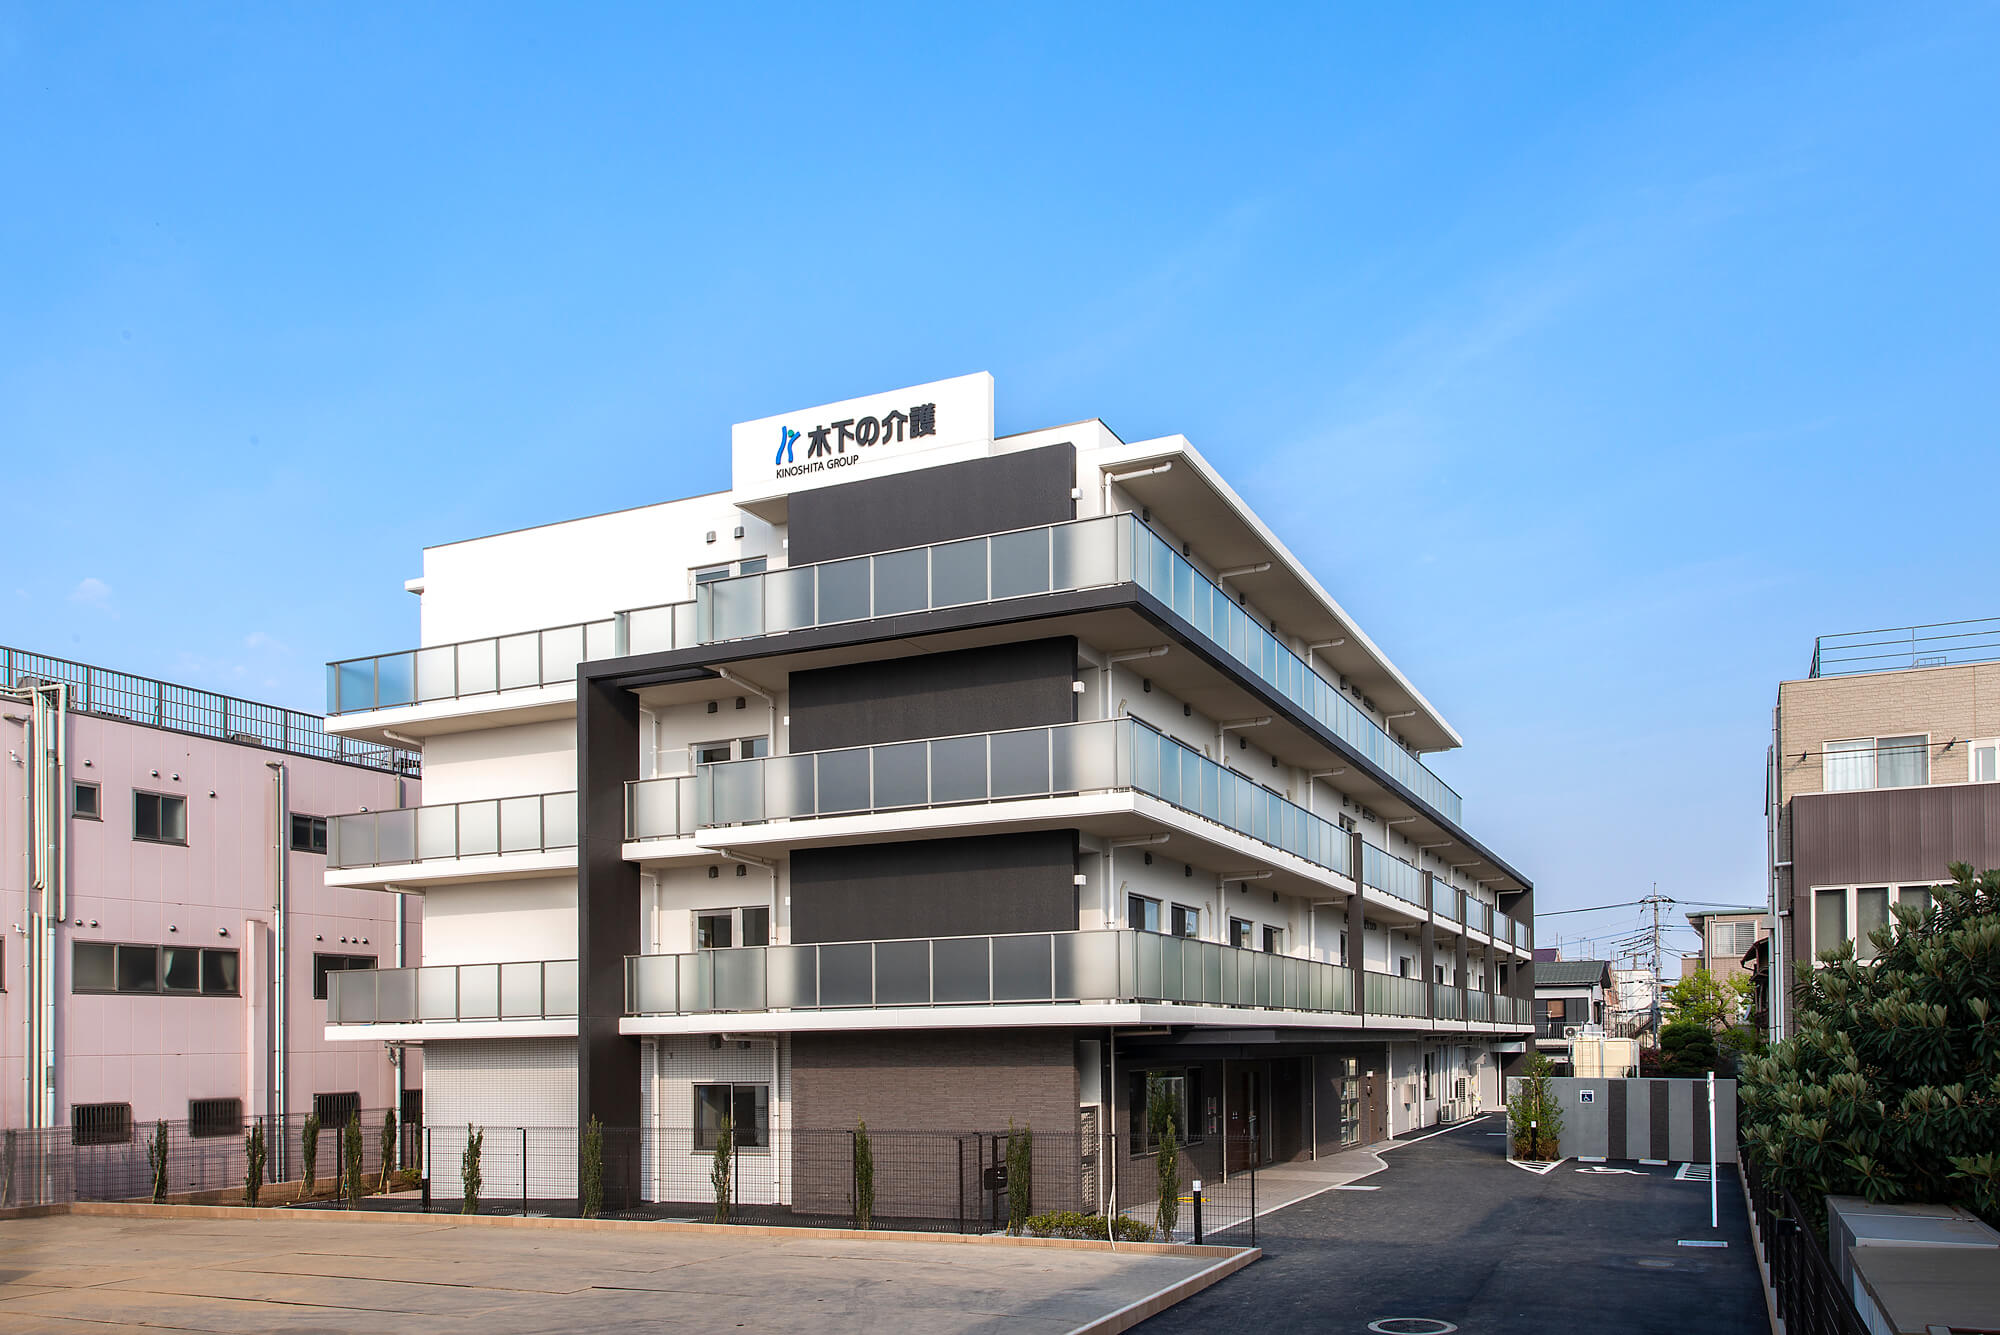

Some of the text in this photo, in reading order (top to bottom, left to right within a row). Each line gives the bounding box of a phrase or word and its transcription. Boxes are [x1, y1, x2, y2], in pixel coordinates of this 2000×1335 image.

[807, 403, 936, 458] 木下の介護
[776, 454, 859, 479] KINOSHITA GROUP
